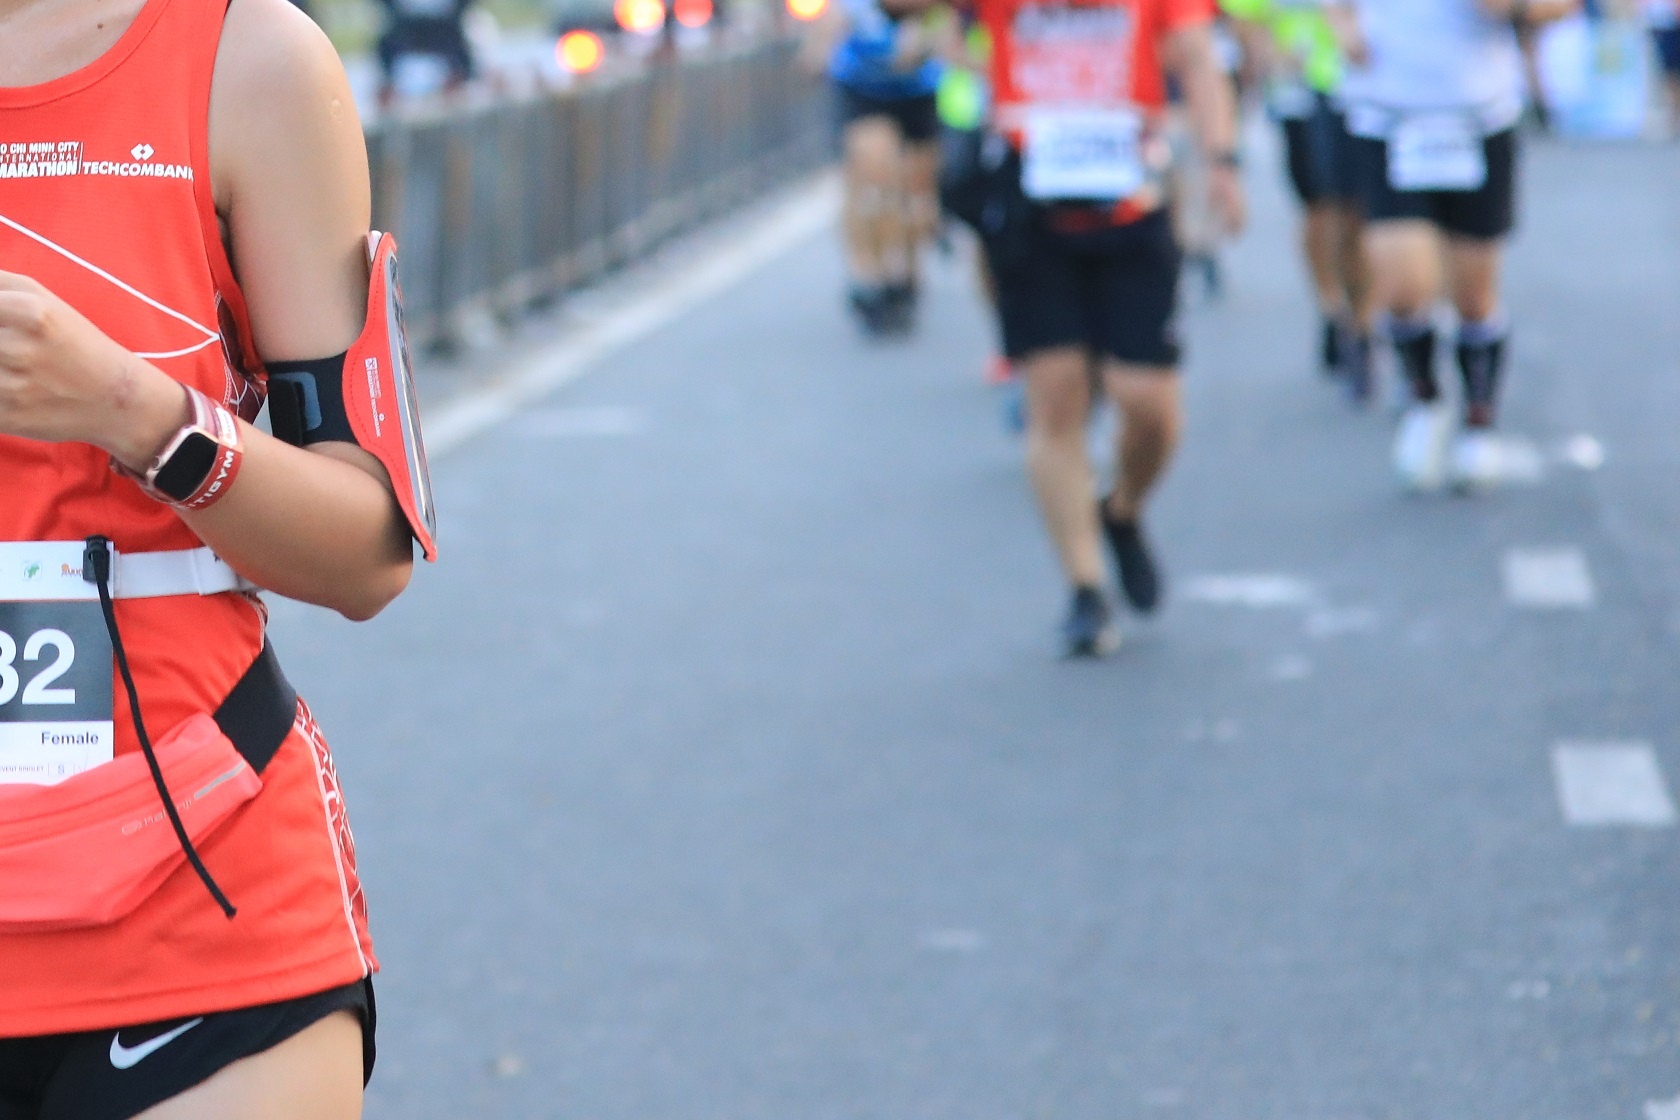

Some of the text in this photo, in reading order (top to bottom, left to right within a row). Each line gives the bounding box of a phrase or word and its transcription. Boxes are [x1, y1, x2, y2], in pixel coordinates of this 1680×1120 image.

[10, 143, 27, 154] CHI
[29, 142, 55, 153] MINH
[57, 141, 79, 152] CITY
[41, 731, 99, 745] Female
